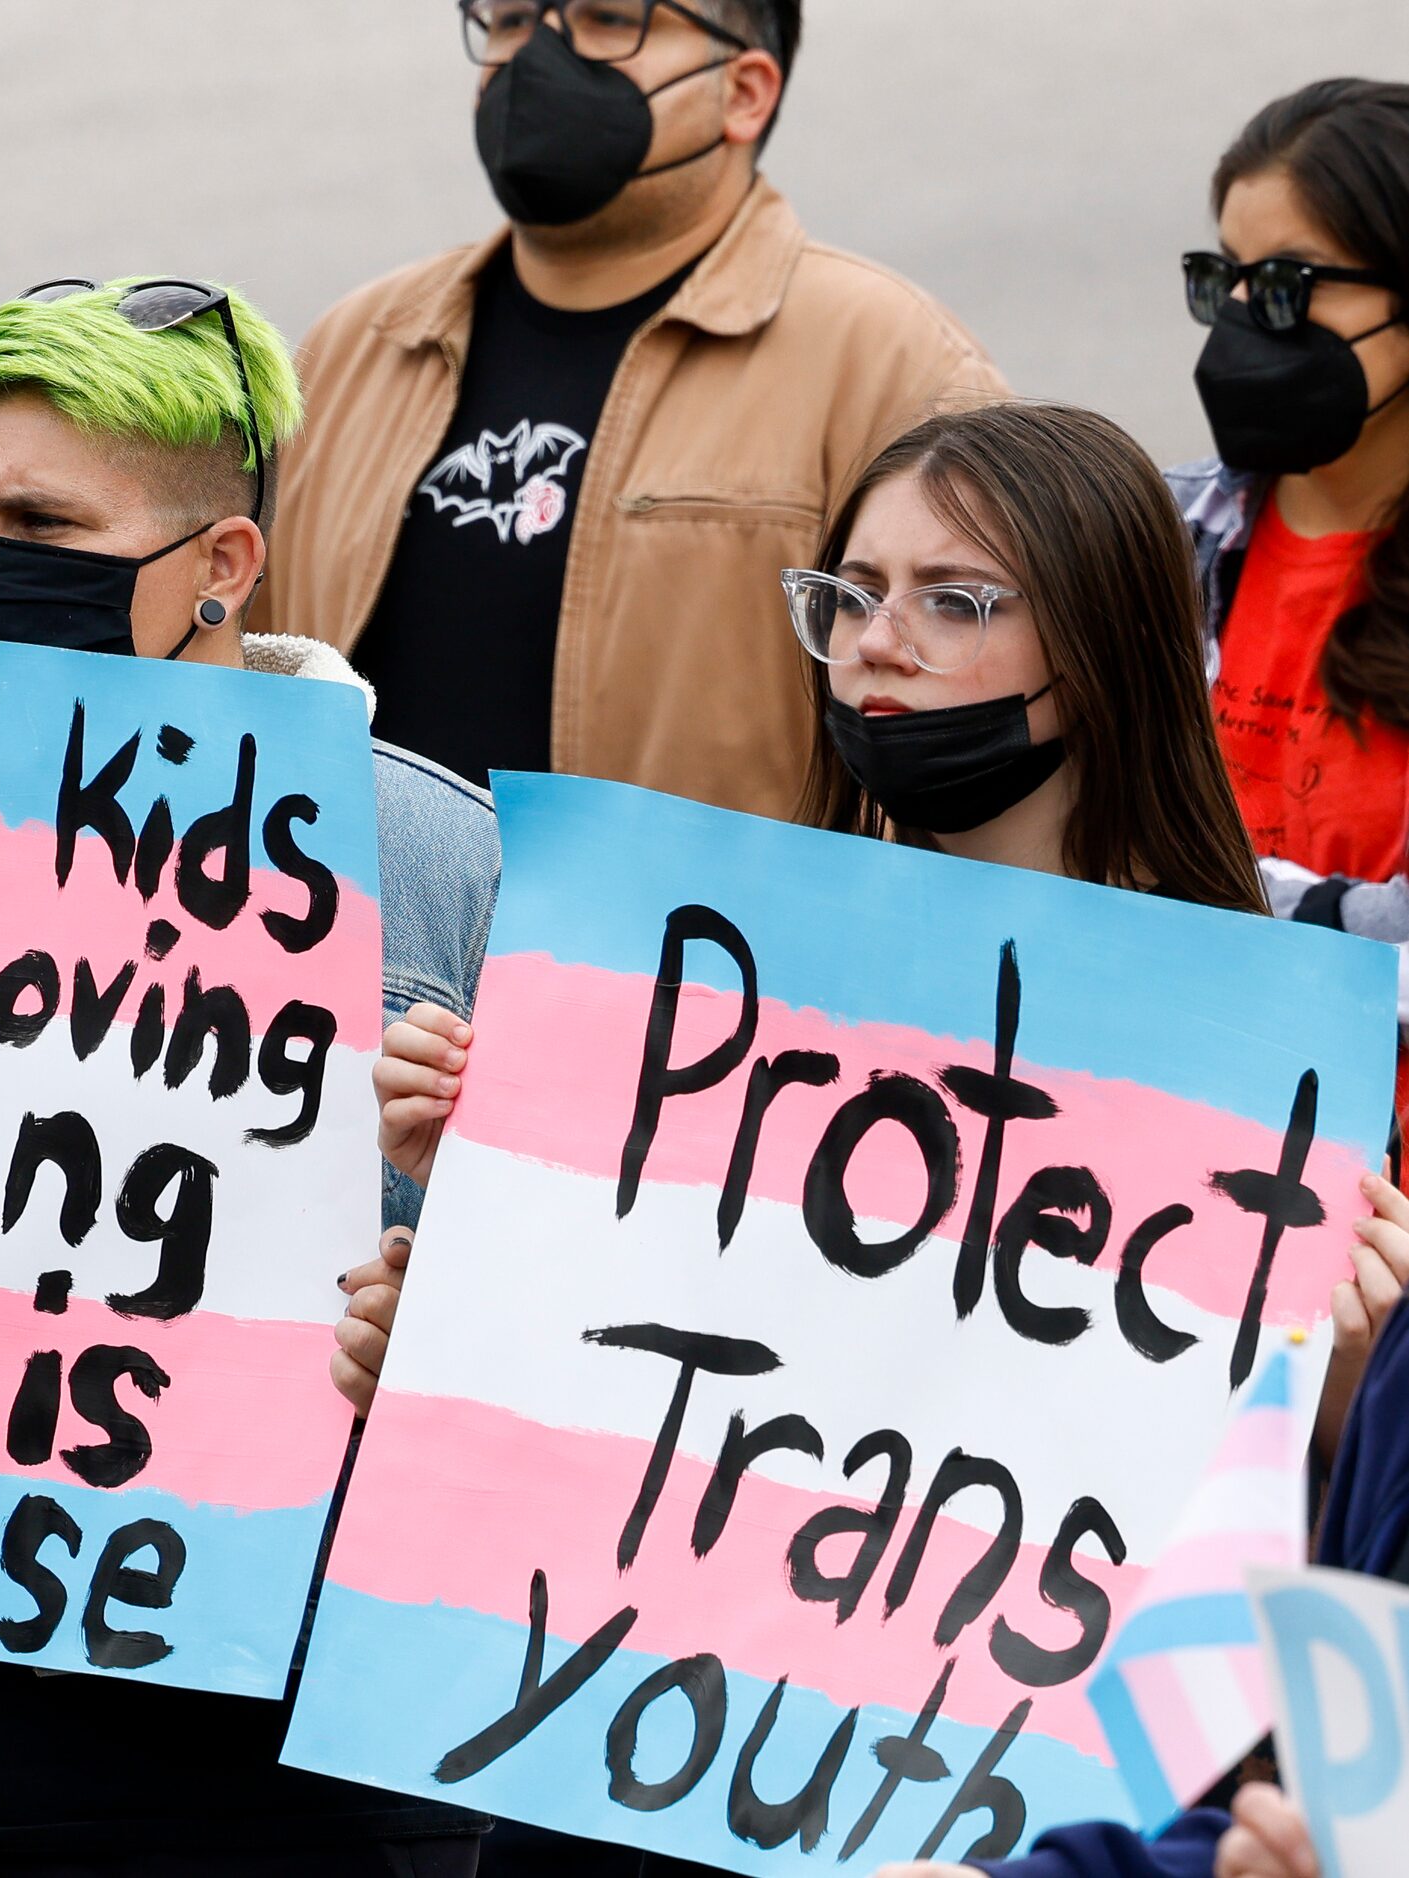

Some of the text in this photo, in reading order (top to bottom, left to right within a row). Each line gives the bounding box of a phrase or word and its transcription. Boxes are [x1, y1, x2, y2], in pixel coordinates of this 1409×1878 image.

[55, 697, 340, 954] Kids
[616, 903, 1325, 1394] Protect
[6, 1268, 172, 1489] is
[581, 1322, 1127, 1688] Trans
[1260, 1583, 1409, 1878] P
